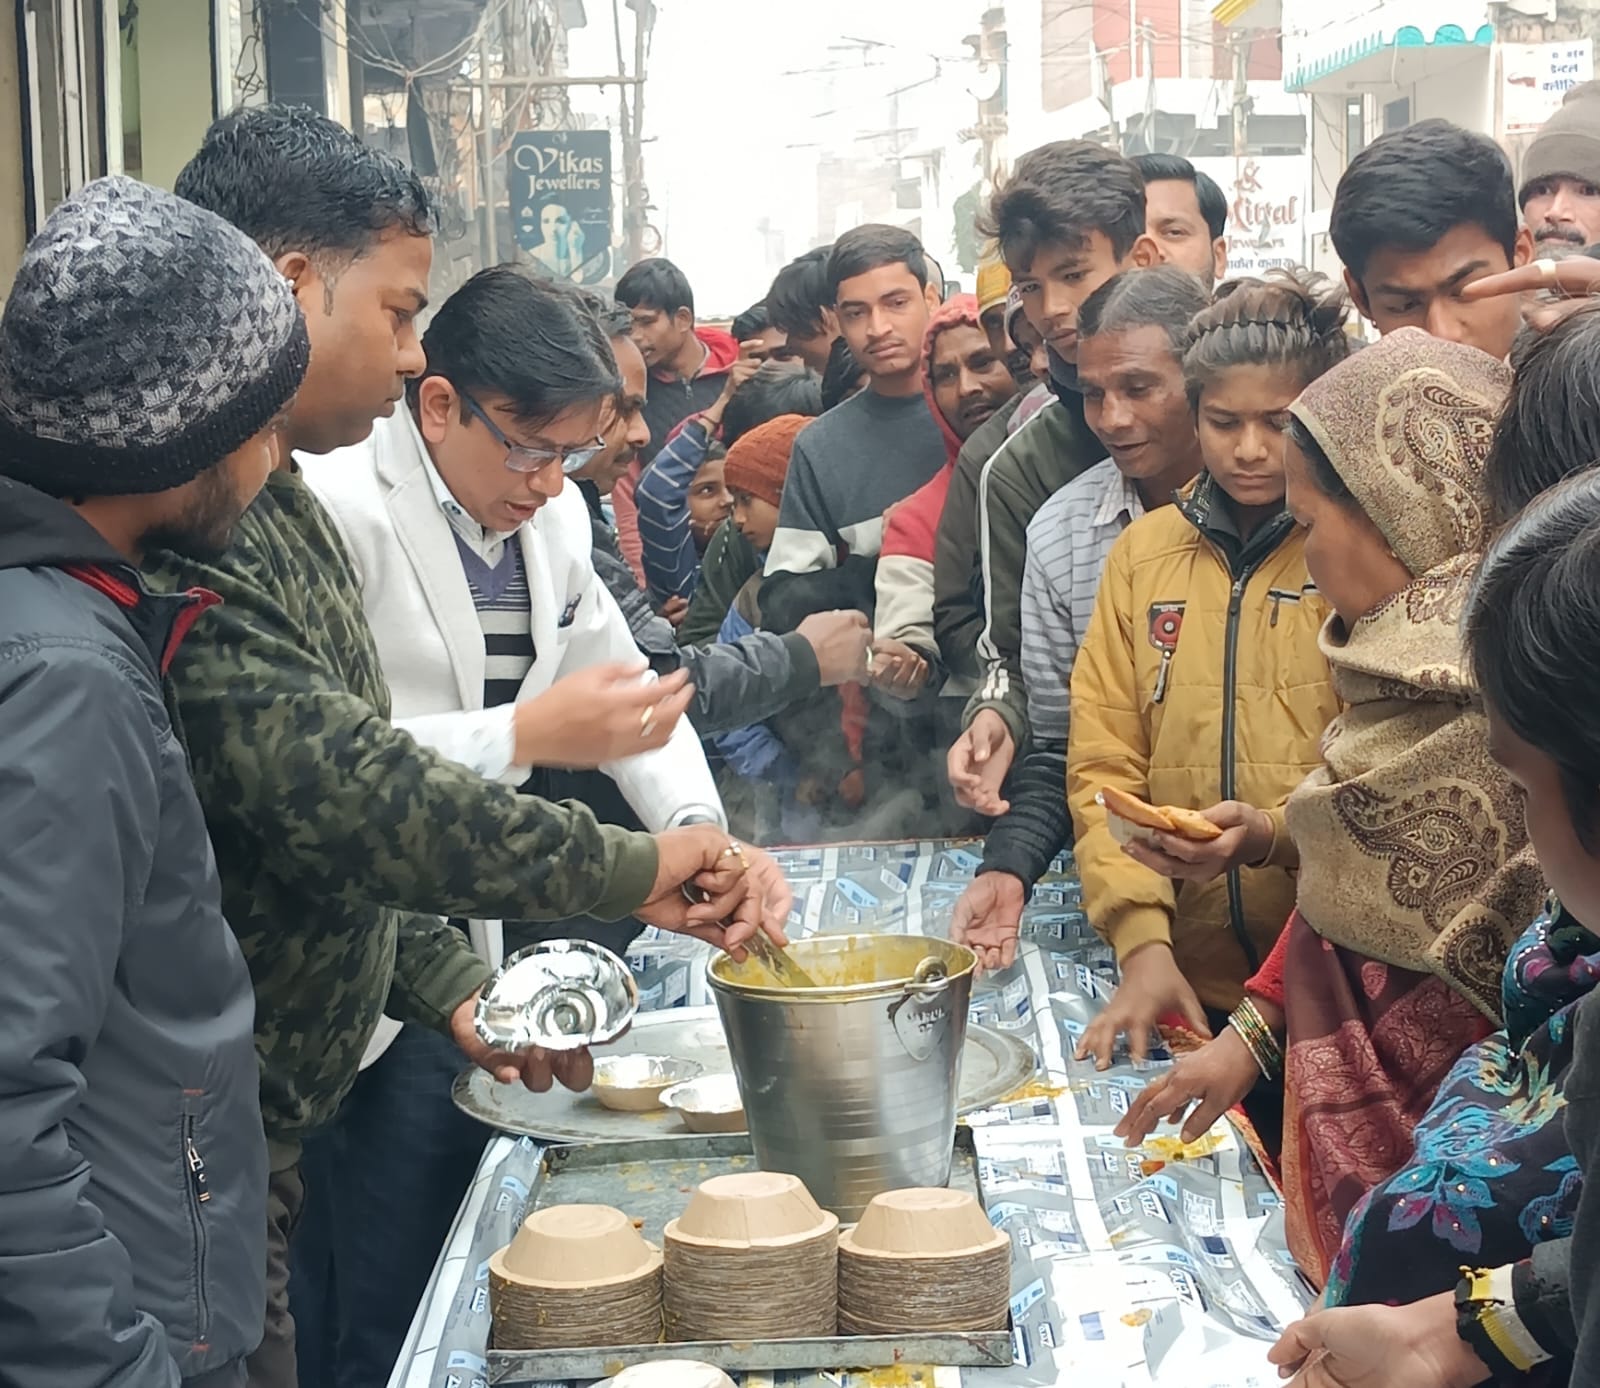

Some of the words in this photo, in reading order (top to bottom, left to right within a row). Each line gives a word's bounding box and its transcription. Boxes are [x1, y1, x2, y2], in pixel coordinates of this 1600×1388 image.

[514, 144, 603, 173] Vikas
[528, 174, 600, 199] Jewellers
[1137, 1190, 1160, 1218] Zero
[1168, 1268, 1194, 1306] Zero
